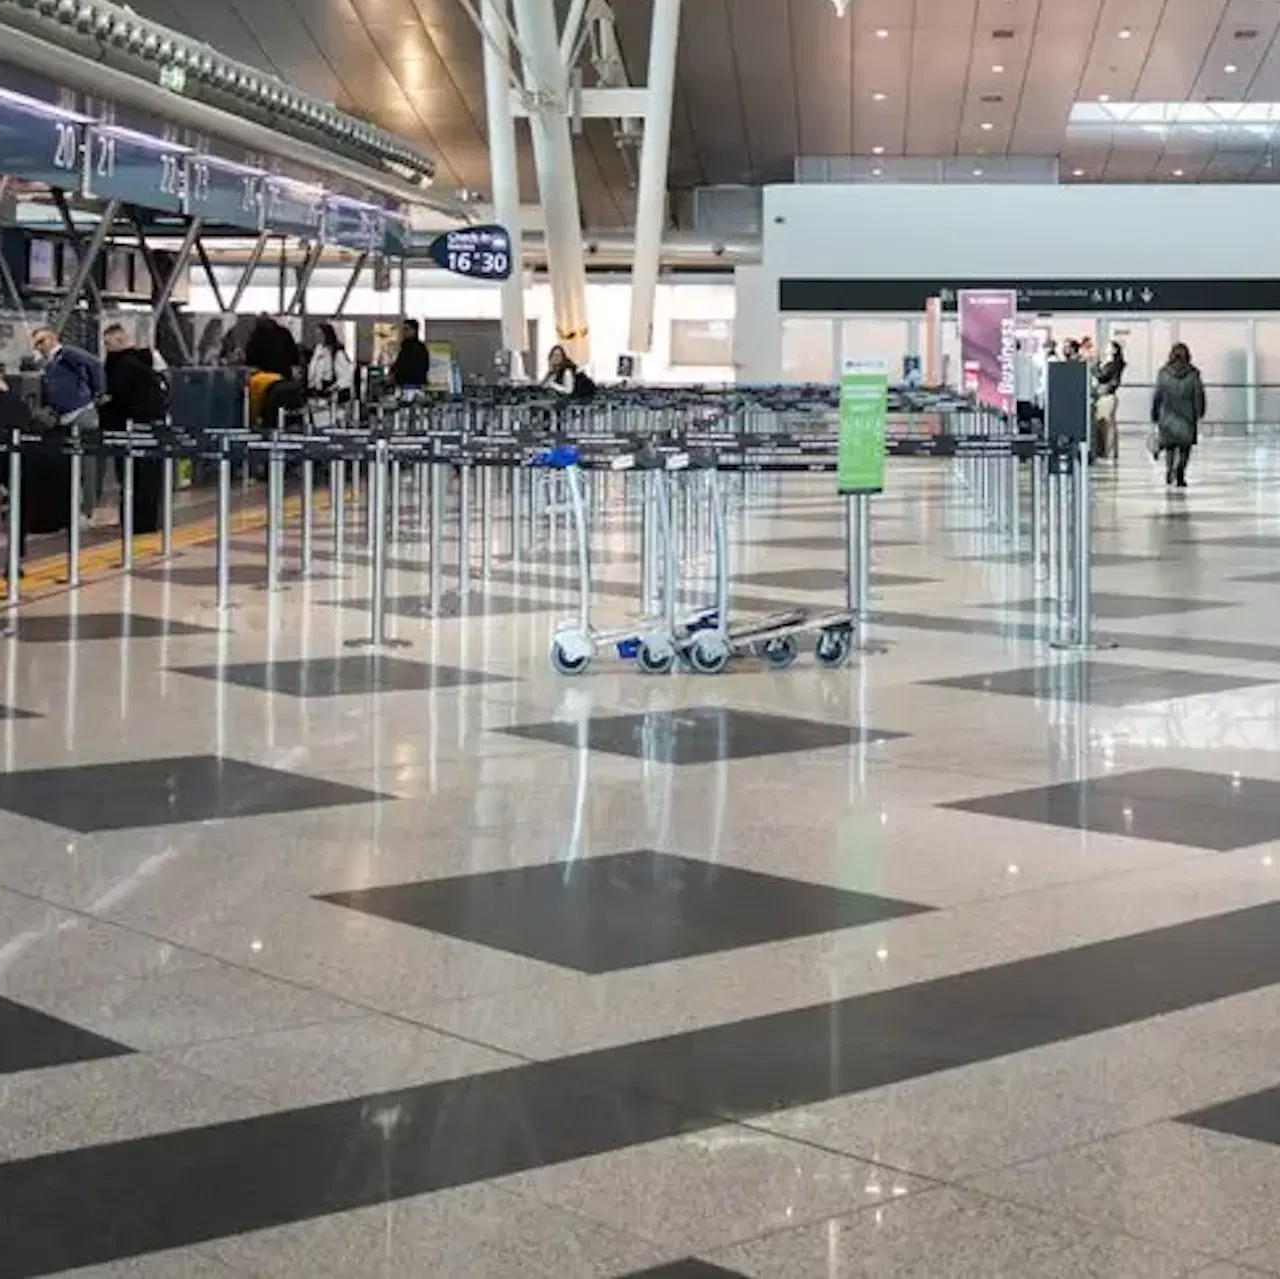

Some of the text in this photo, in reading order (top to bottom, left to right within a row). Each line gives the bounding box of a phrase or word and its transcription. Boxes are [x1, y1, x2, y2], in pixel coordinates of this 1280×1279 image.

[53, 122, 76, 170] 20
[96, 135, 116, 178] 21
[448, 251, 472, 272] 16
[481, 251, 508, 274] 30
